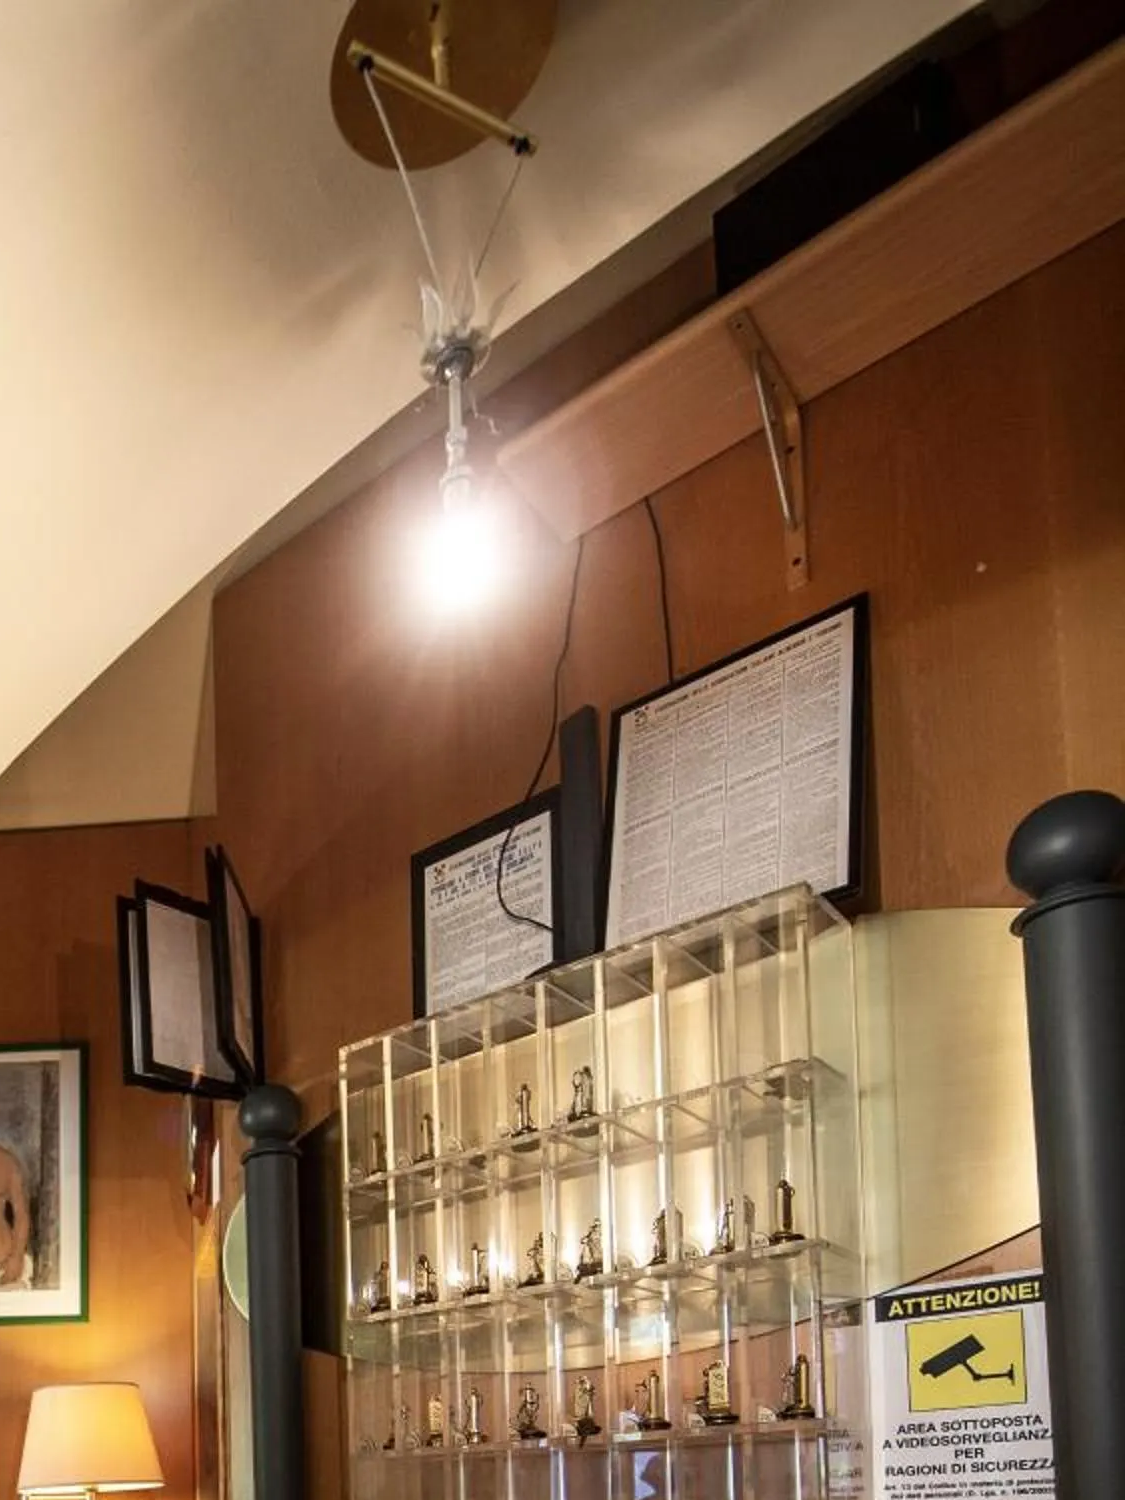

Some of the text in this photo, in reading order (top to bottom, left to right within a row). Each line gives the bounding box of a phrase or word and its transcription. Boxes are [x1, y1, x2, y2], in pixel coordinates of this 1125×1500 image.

[888, 1281, 1040, 1317] ATTENZIONE!
[896, 1414, 1043, 1435] AREA SOTTOPOSTA
[883, 1428, 1054, 1450] A VIDEOSORVEGLIANZ
[954, 1447, 985, 1459] PER
[885, 1464, 947, 1477] RAGIONI
[951, 1463, 966, 1475] DI
